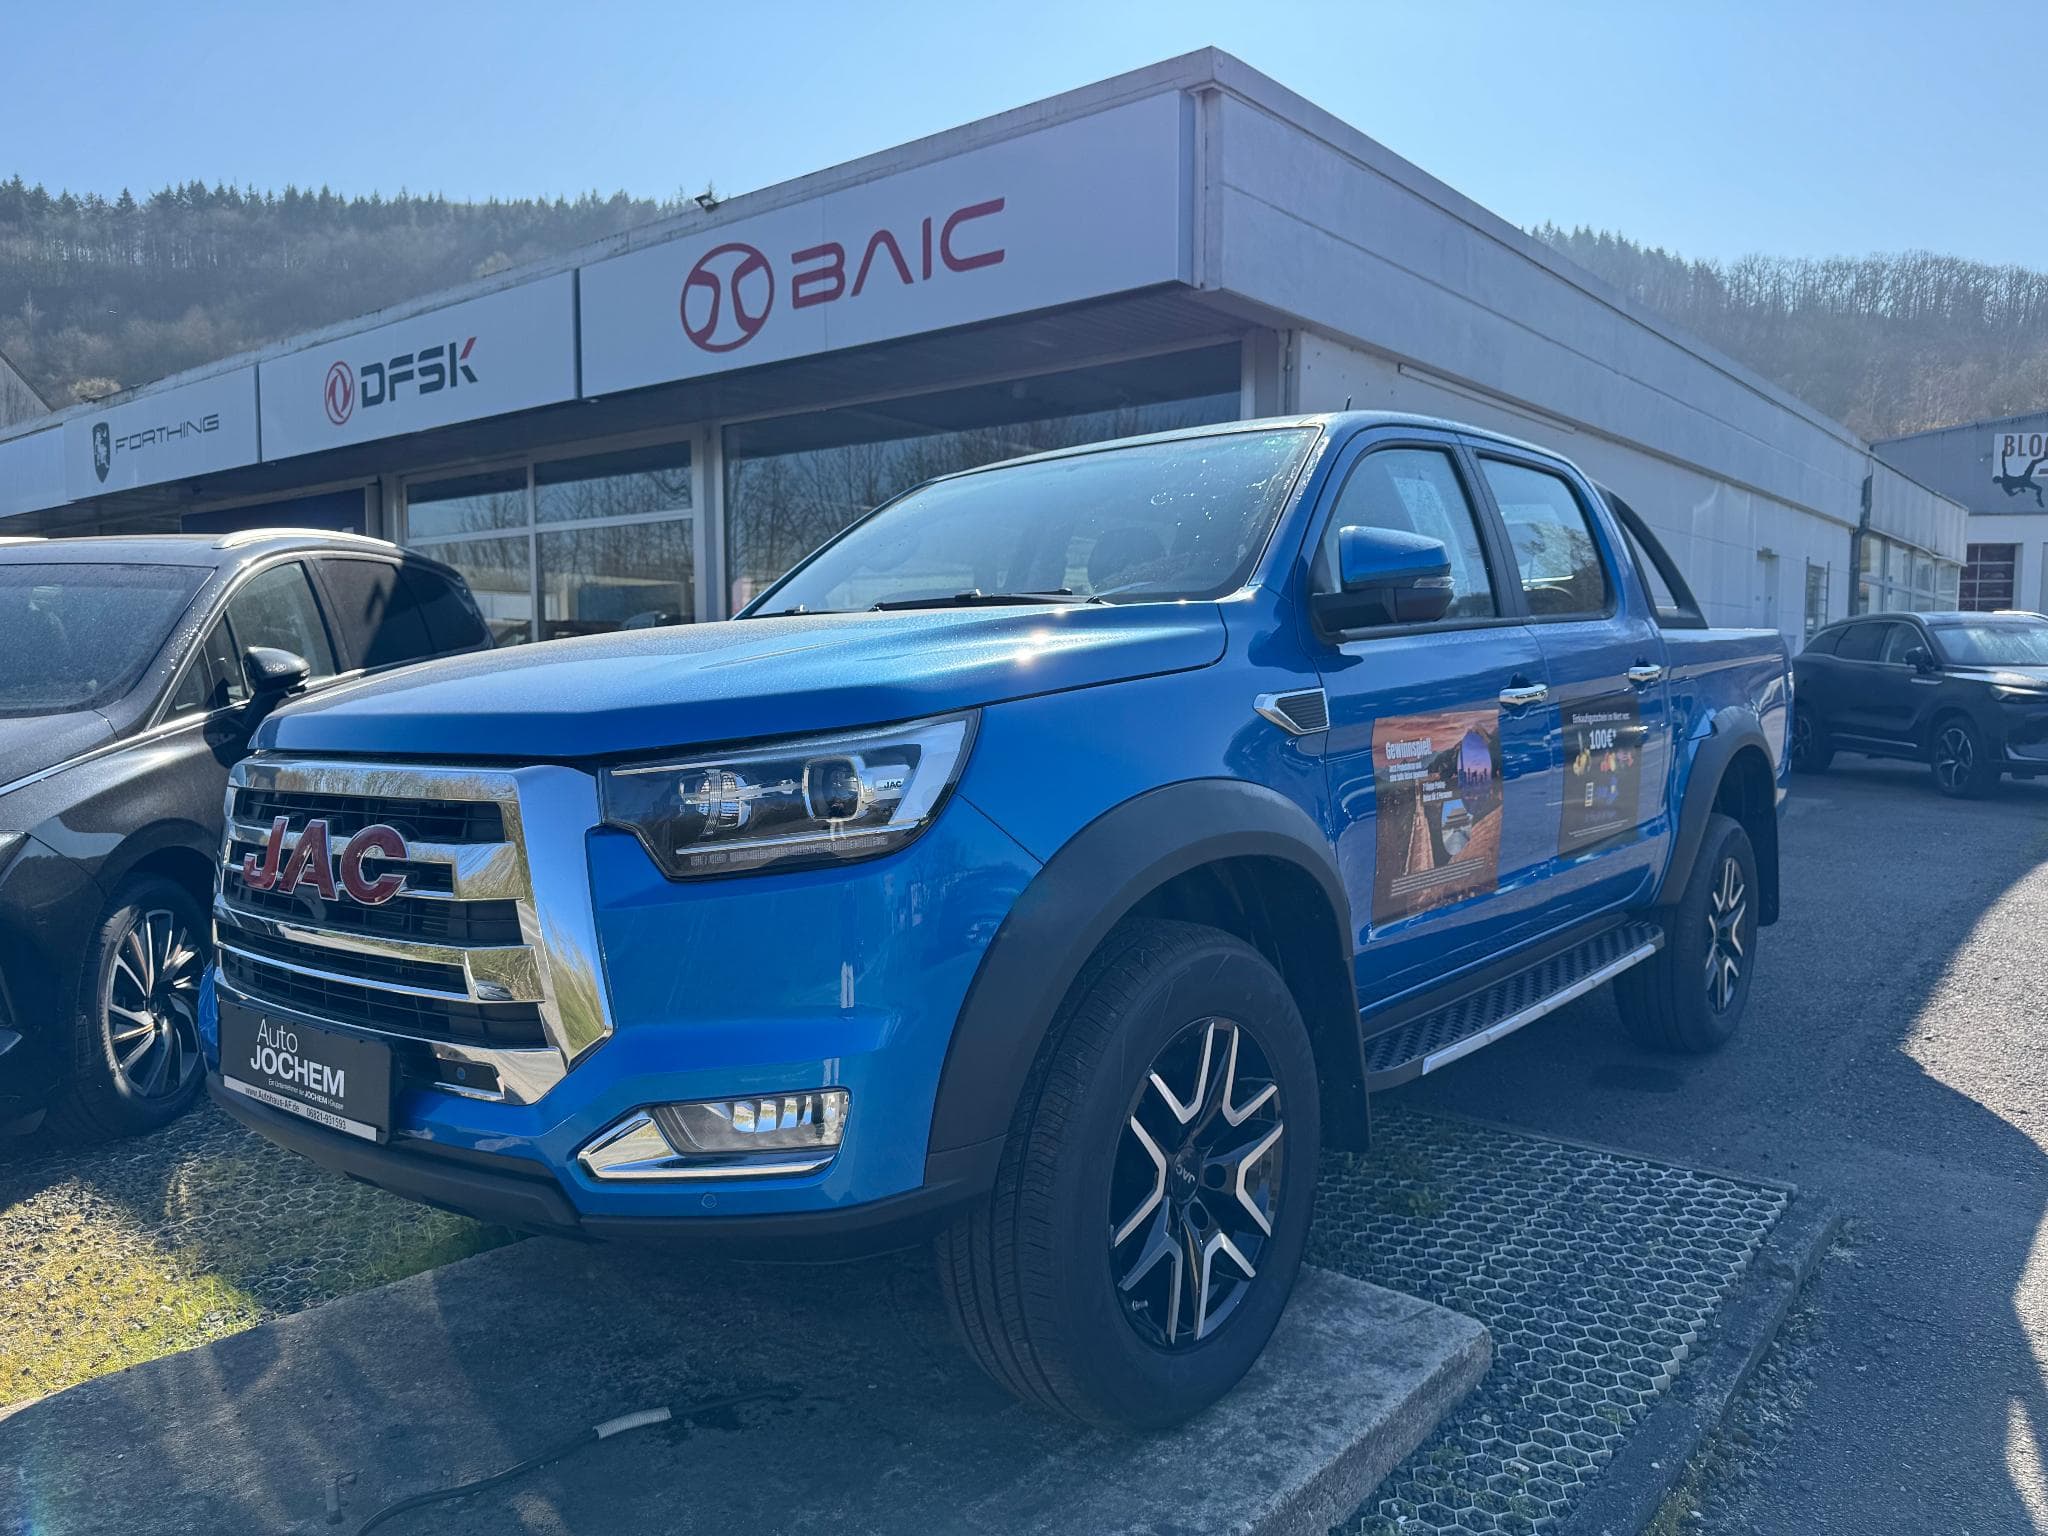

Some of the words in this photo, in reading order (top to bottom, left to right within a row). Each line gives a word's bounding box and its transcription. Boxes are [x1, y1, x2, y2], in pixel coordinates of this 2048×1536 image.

[791, 197, 1005, 310] BAIC
[361, 336, 479, 408] DFSK
[115, 413, 219, 455] FORTHING
[2004, 434, 2048, 457] BLO
[884, 780, 902, 789] JAC
[243, 815, 411, 906] JAC
[257, 1018, 298, 1053] Auto
[250, 1045, 345, 1098] JOCHEM
[304, 1091, 328, 1105] JOCHEM
[1175, 1164, 1196, 1184] JAC
